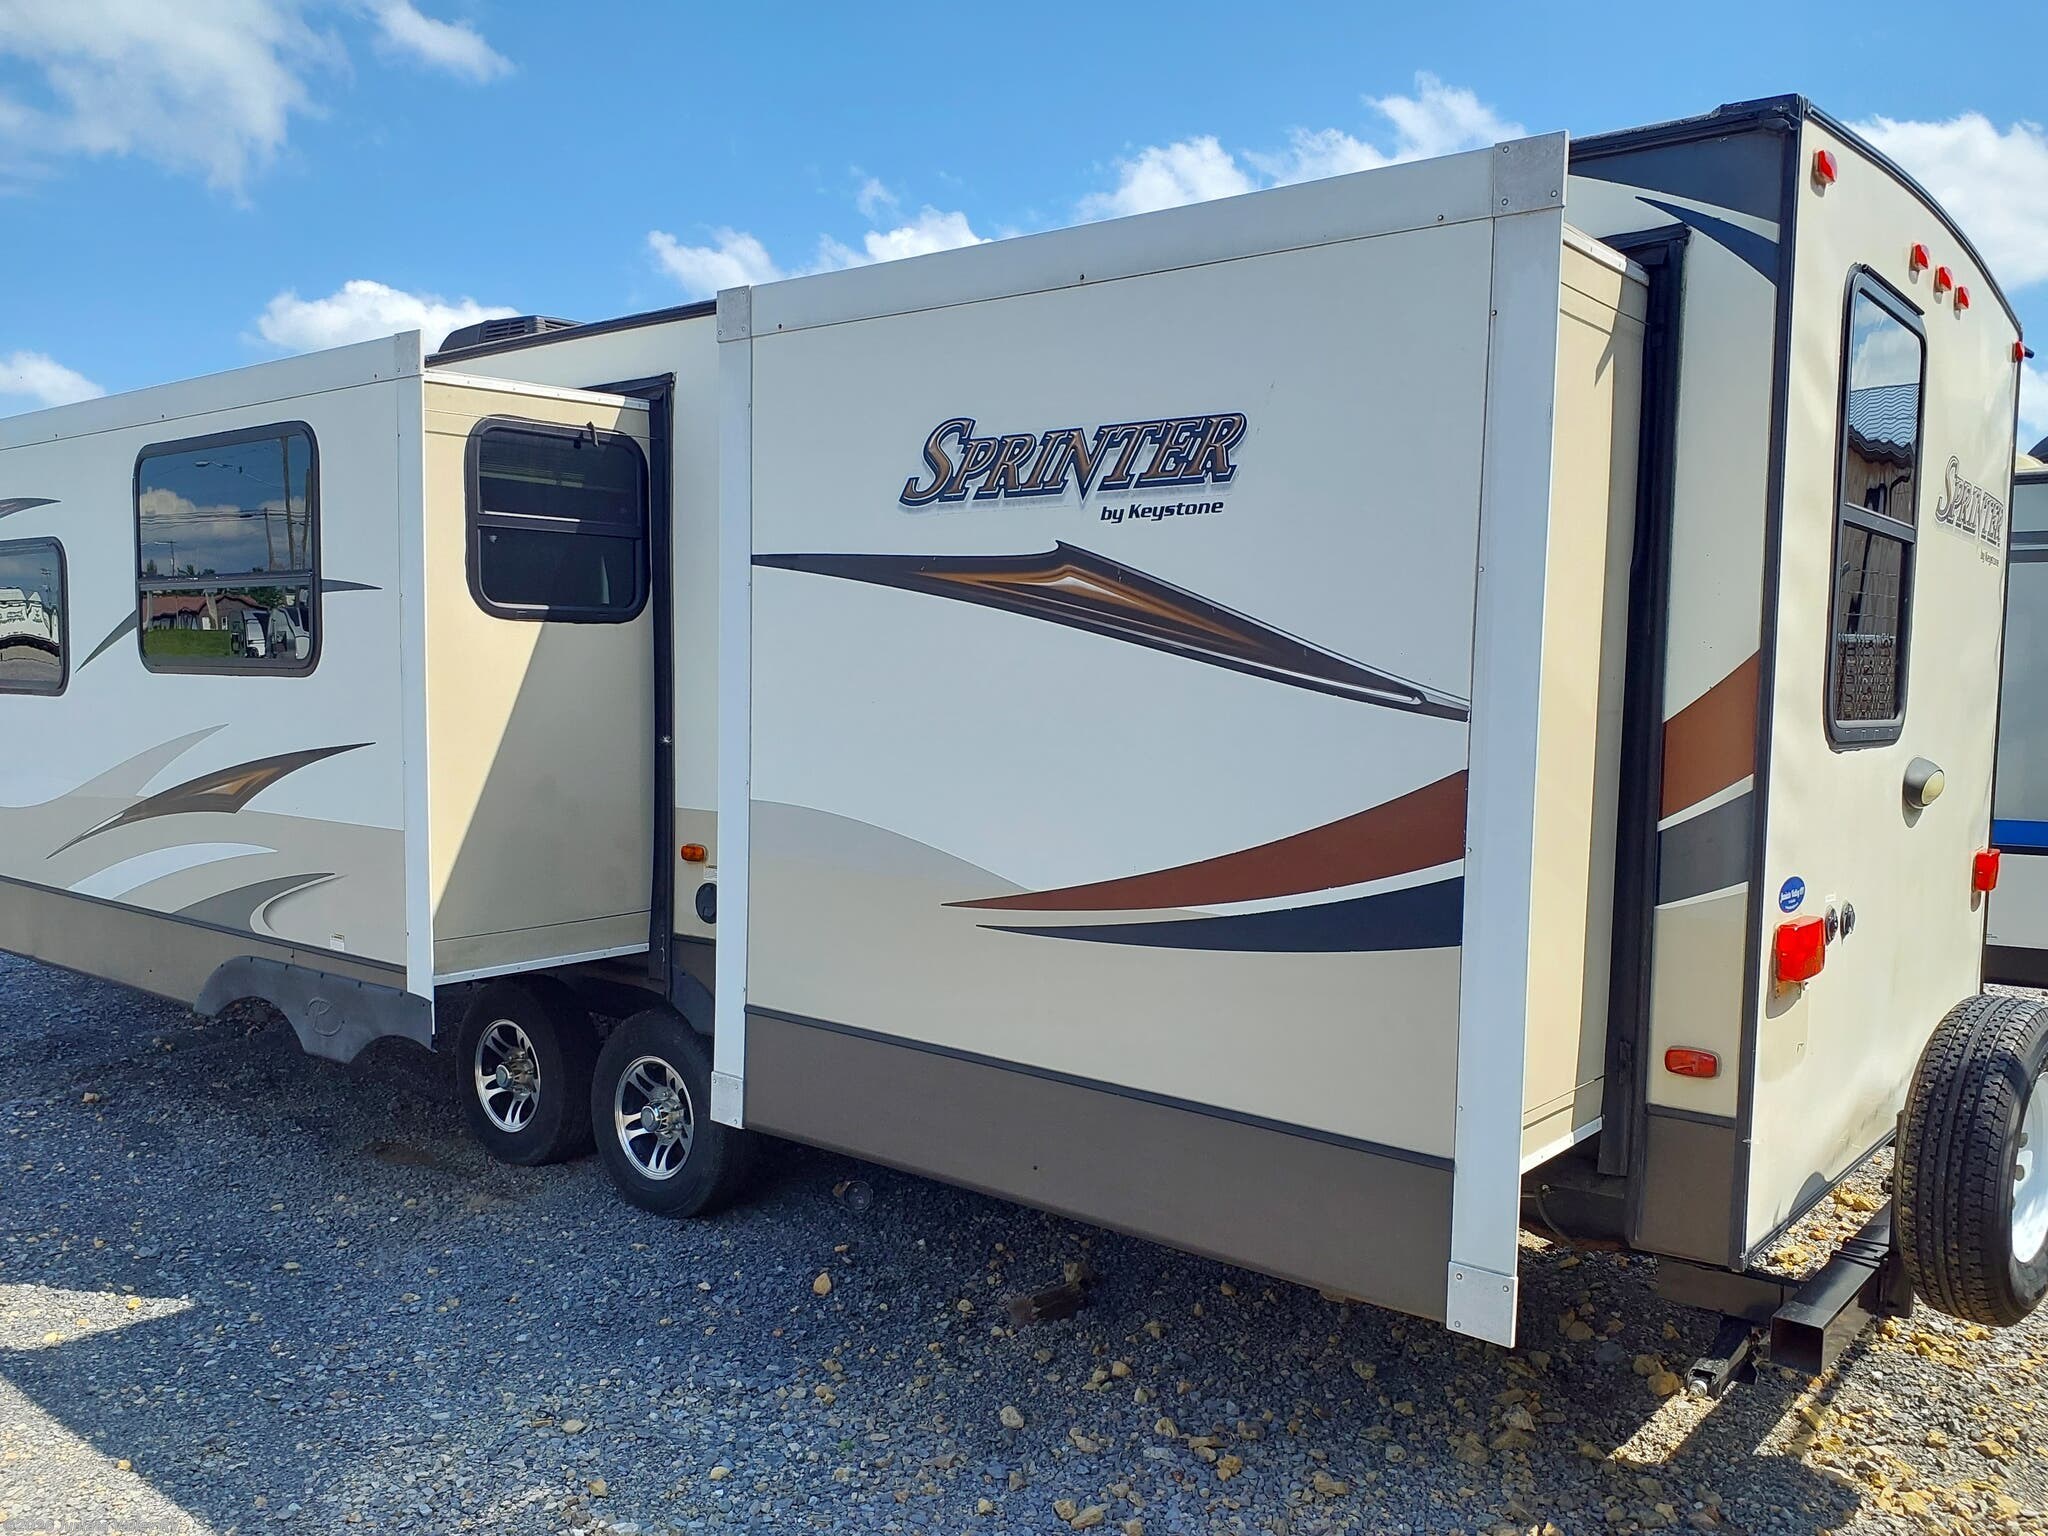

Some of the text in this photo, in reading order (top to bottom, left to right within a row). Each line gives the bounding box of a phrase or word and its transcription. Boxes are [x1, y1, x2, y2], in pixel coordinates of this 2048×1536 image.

[900, 412, 1247, 506] SPRINTER
[1935, 455, 2004, 548] SPRINTER
[1100, 501, 1224, 524] by Keystone
